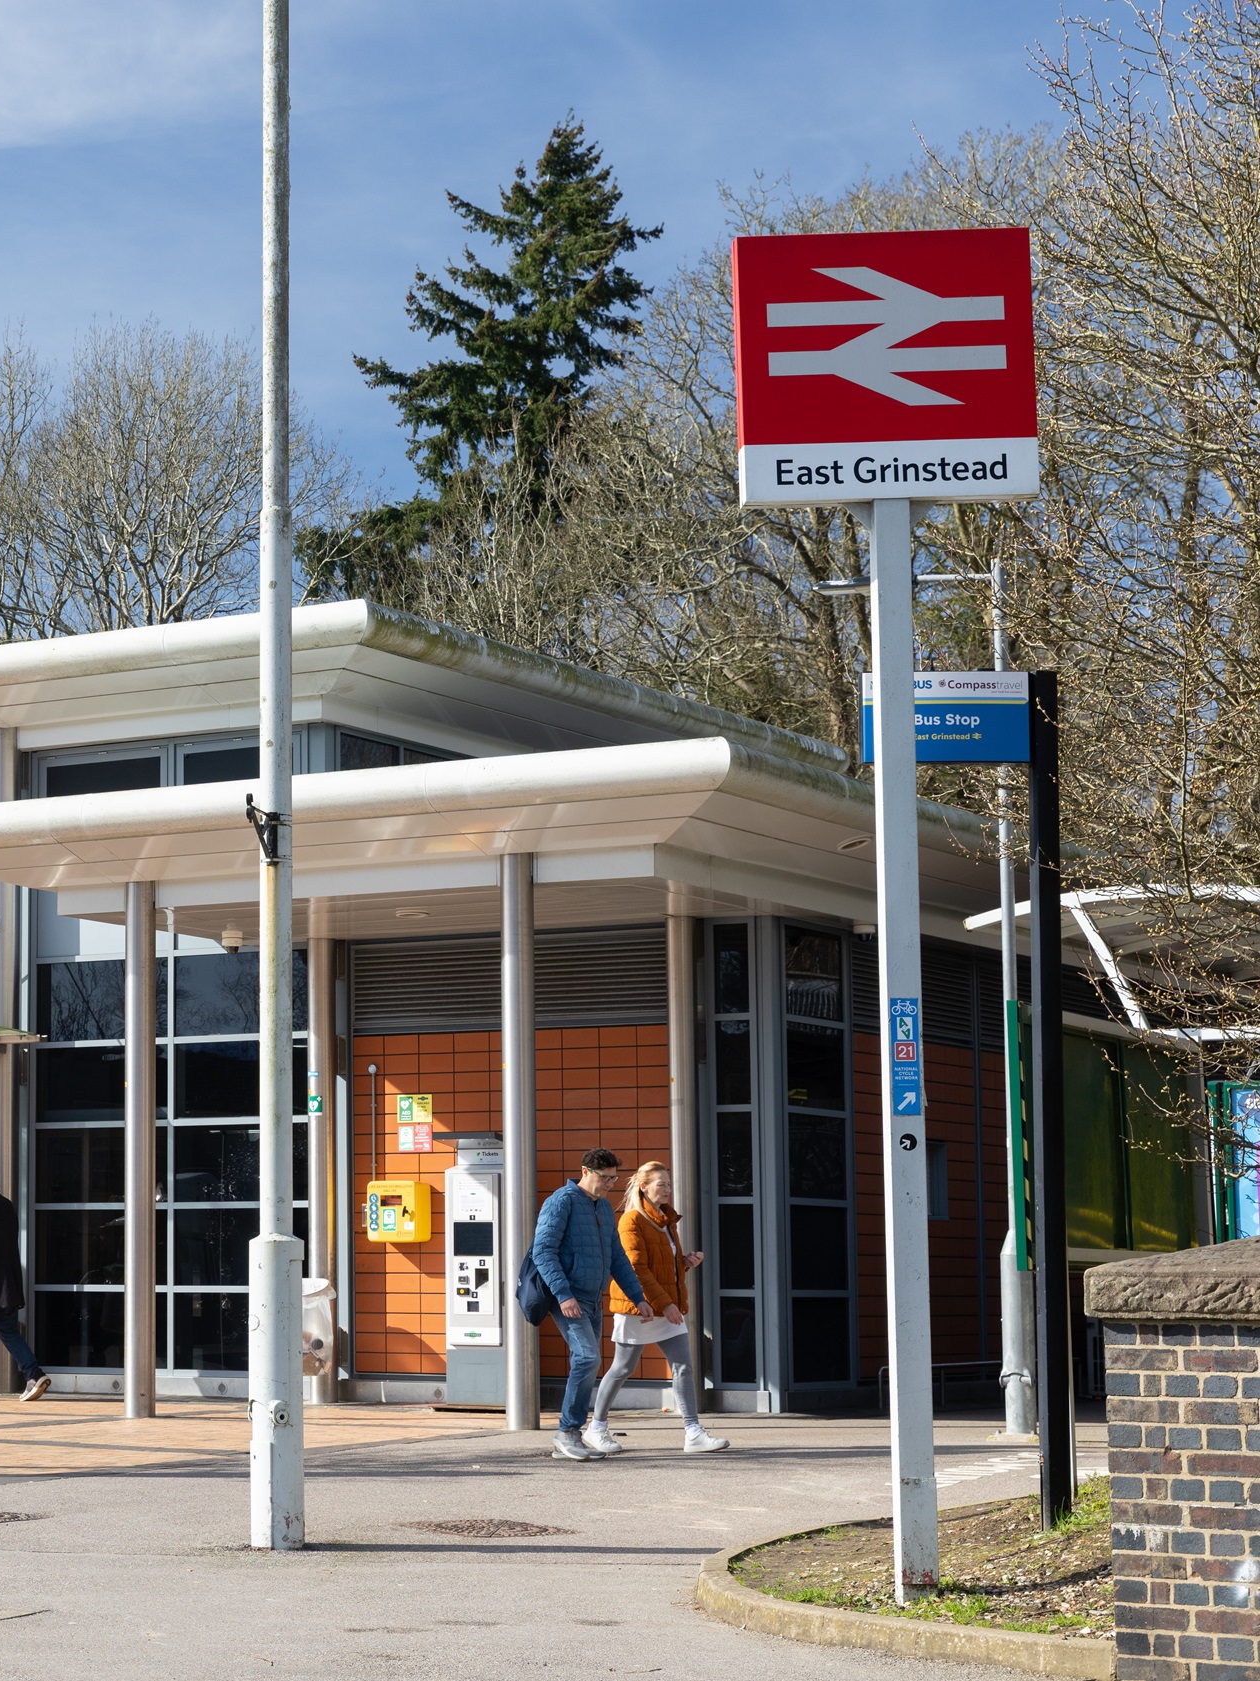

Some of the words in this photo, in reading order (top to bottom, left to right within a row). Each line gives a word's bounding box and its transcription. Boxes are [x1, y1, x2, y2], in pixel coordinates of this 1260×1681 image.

[776, 459, 844, 486] East
[853, 453, 1008, 483] Grinstead
[914, 713, 941, 726] Bus
[945, 713, 981, 728] Stop
[931, 732, 971, 741] Grinstead
[897, 1045, 913, 1058] 21
